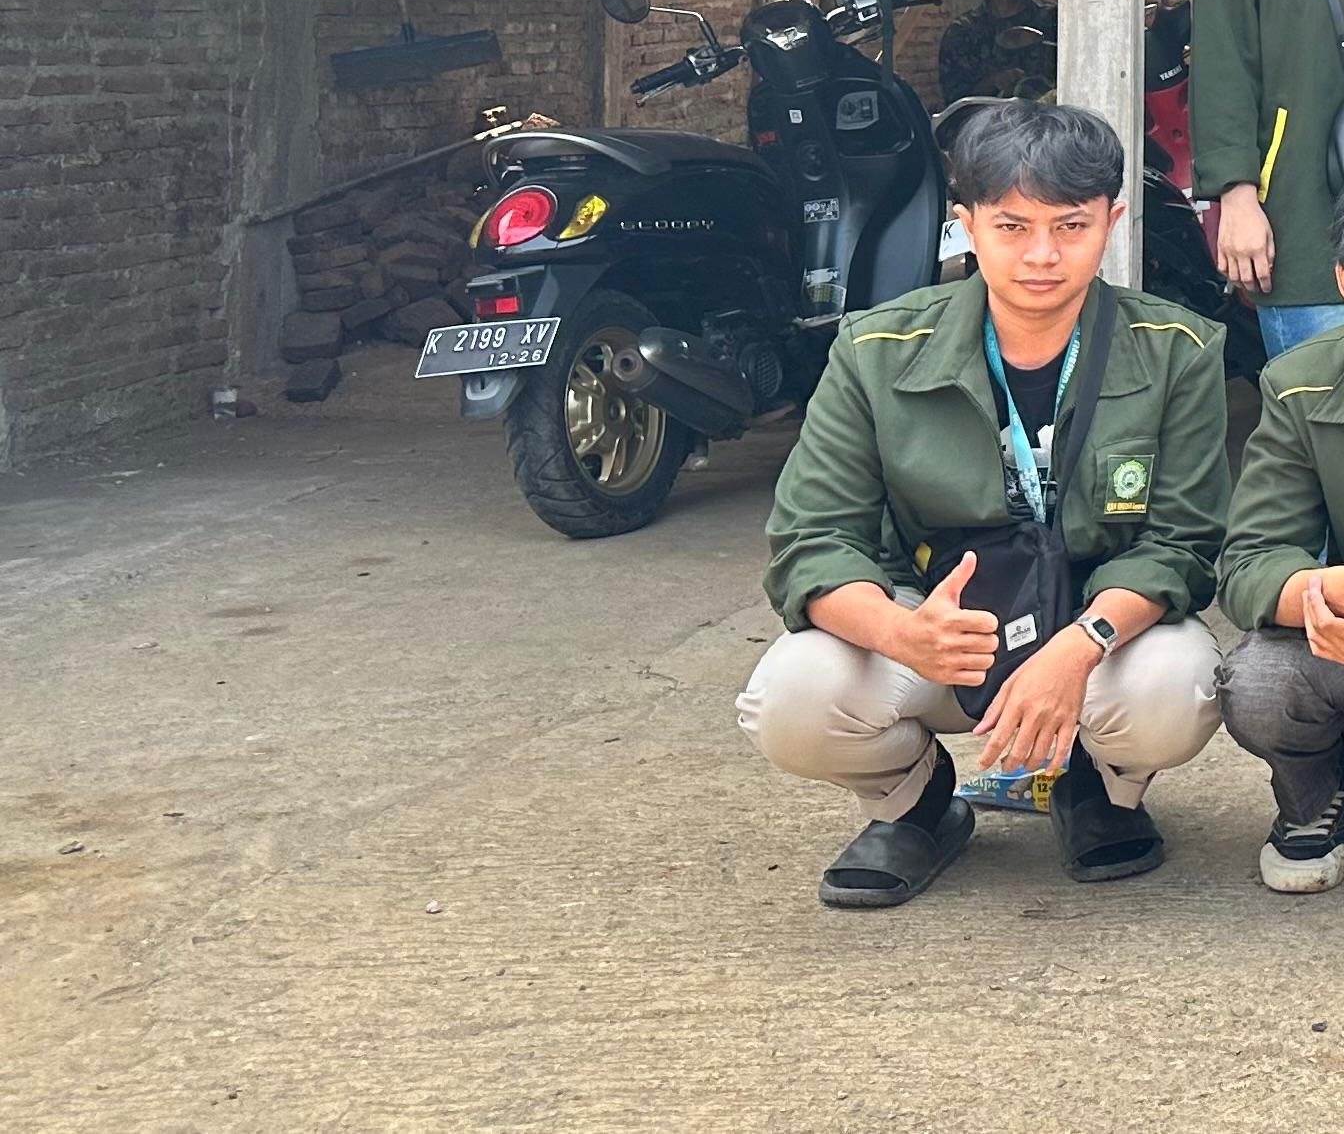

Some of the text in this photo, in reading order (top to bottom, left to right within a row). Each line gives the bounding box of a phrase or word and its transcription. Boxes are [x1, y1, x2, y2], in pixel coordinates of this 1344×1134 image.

[943, 221, 956, 241] K
[427, 323, 551, 355] K 2199 XV
